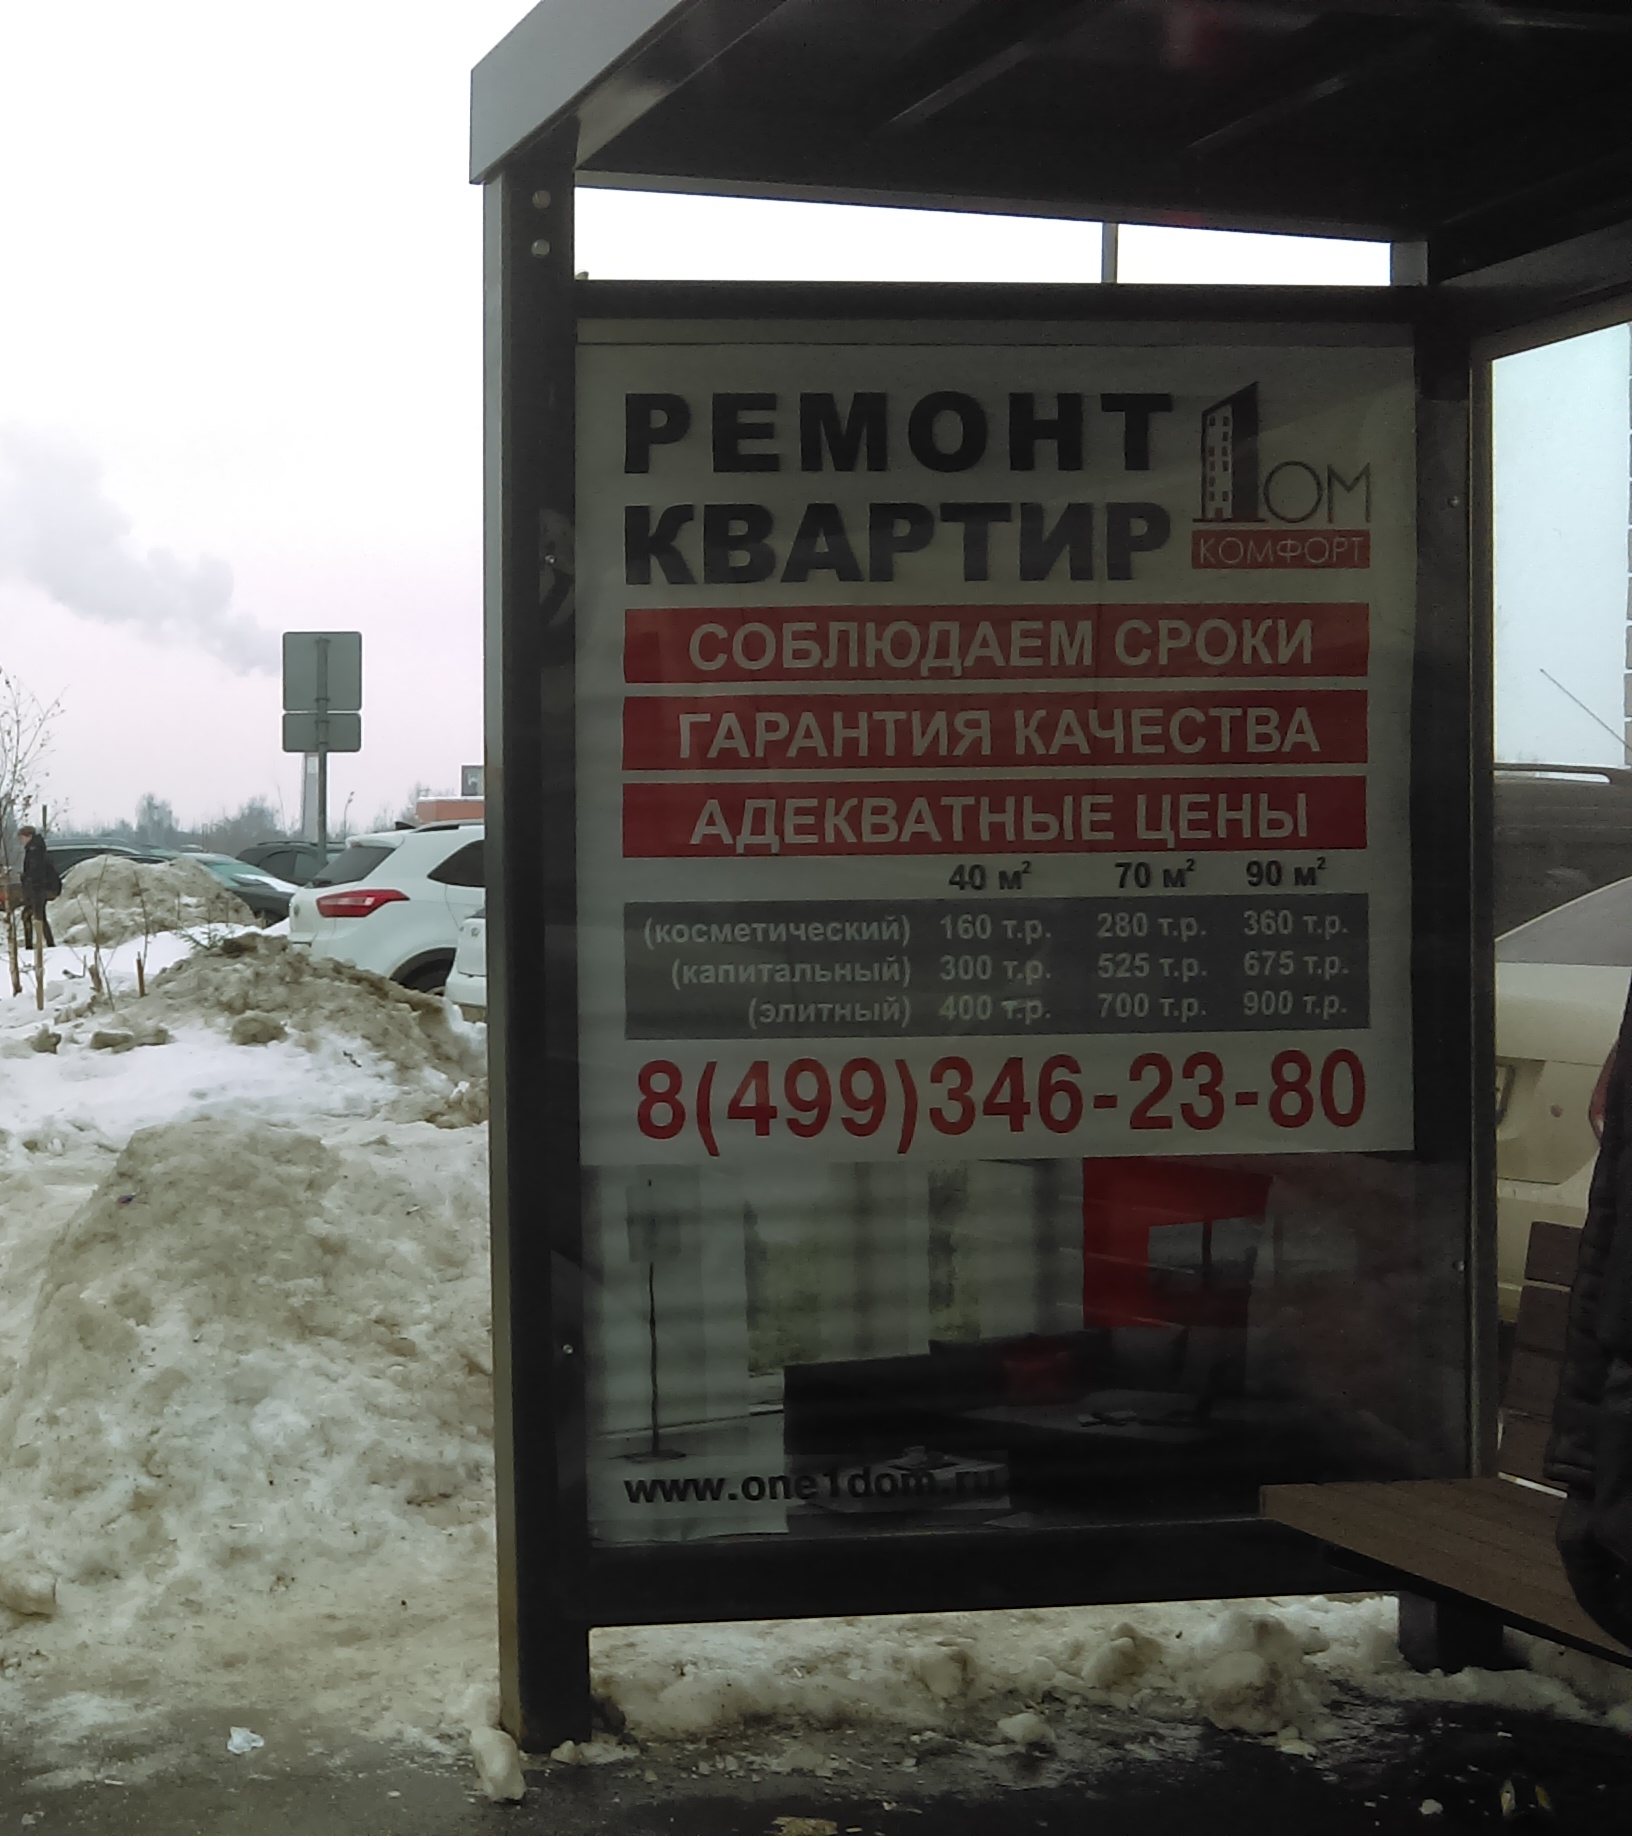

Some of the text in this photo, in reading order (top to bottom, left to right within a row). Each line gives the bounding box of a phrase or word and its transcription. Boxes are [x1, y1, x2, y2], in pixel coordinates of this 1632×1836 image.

[624, 391, 1173, 474] РЕМОНТ
[624, 501, 1169, 585] КВАРТИР
[1200, 537, 1364, 563] КОМФОРТ
[689, 619, 1312, 676] СОБЛЮДАЕМ СРОКИ
[679, 708, 1320, 758] ГАРАНТИЯ КАЧЕСТВА
[690, 793, 1308, 853] АДЕКВАТНЫЕ ЦЕНЫ
[949, 864, 986, 891] 40
[1115, 862, 1151, 888] 70
[1246, 861, 1282, 887] 90
[643, 914, 911, 949] (косметический)
[941, 914, 992, 939] 160
[1097, 912, 1148, 938] 280
[1244, 910, 1293, 935] 360
[672, 957, 910, 990] (капитальный)
[940, 955, 992, 981] 300
[1099, 953, 1149, 978] 525
[1244, 951, 1294, 975] 675
[749, 995, 911, 1029] (элитный)
[939, 995, 992, 1020] 400
[1098, 993, 1149, 1017] 700
[1244, 990, 1293, 1015] 900
[637, 1048, 1366, 1155] 8(499)346-23-80
